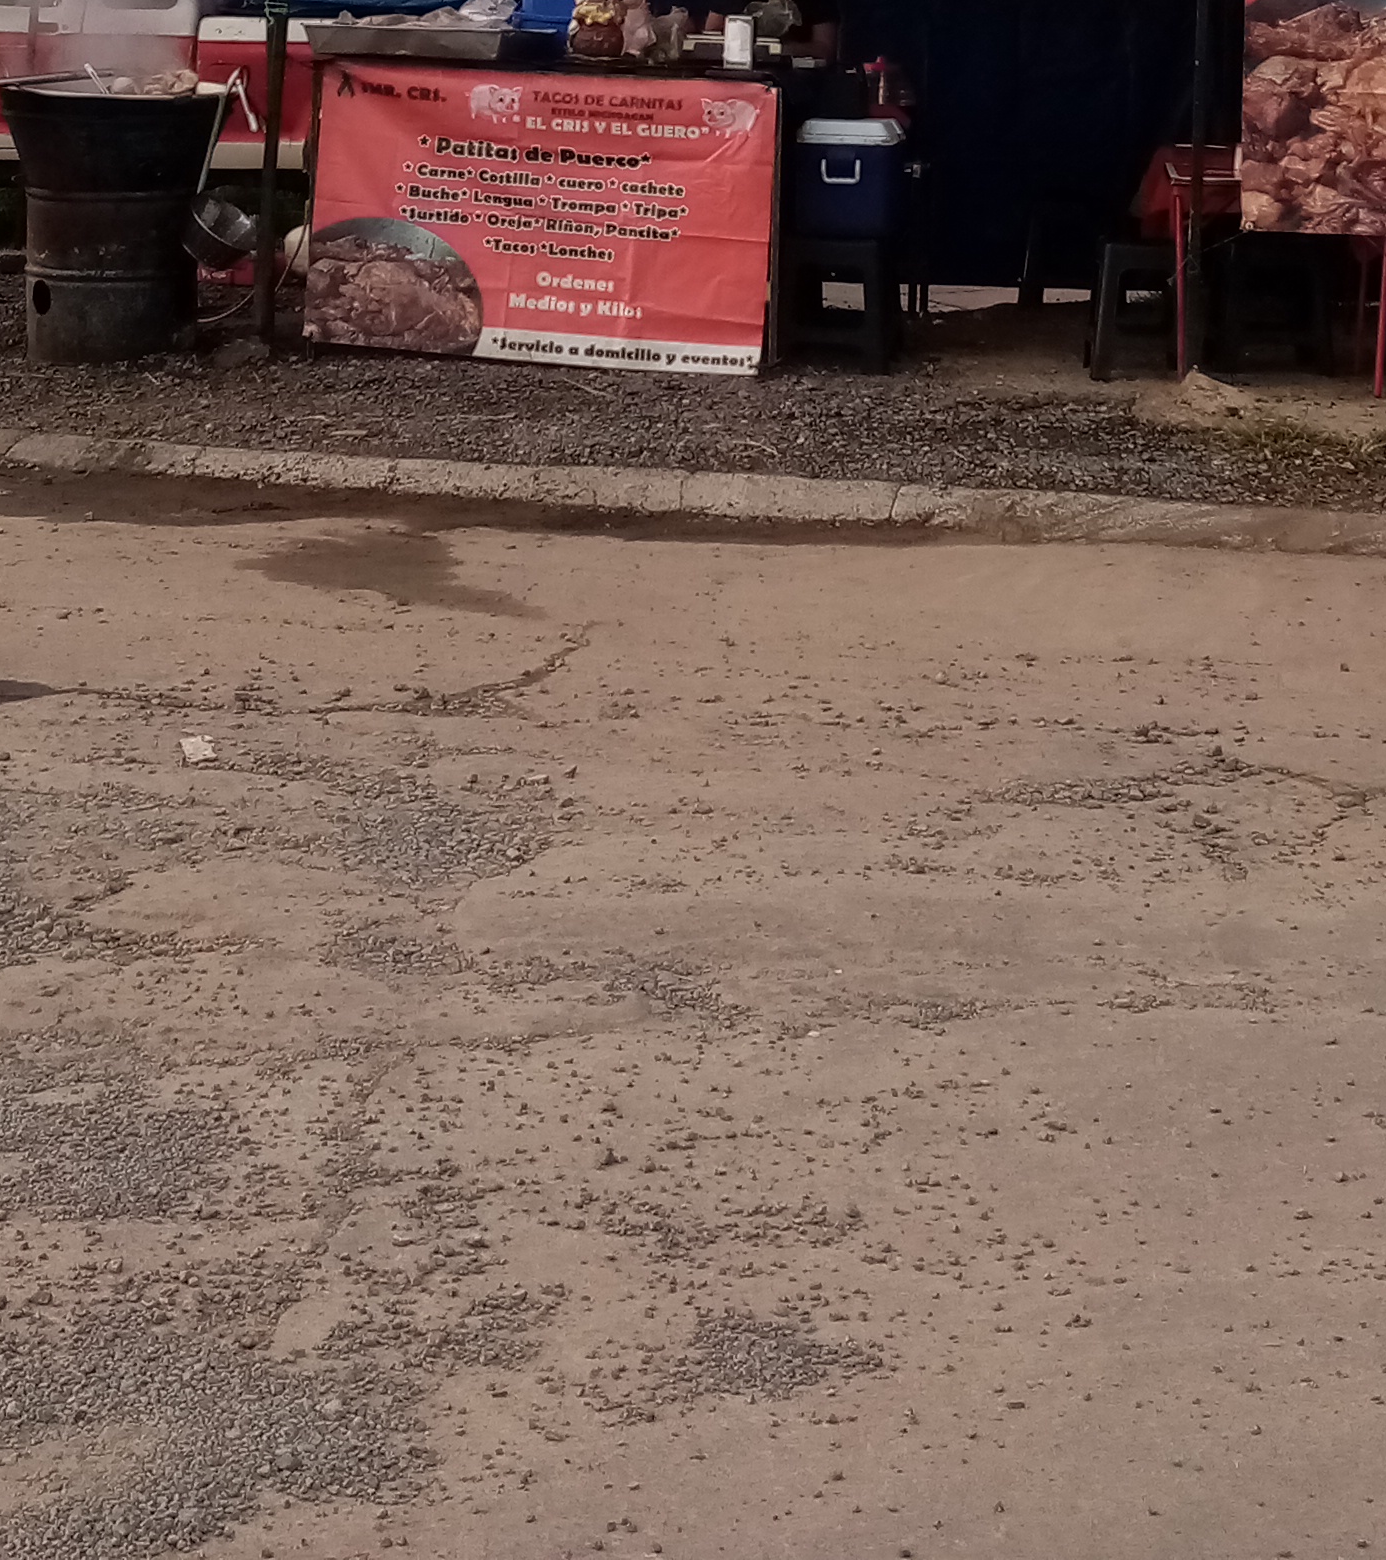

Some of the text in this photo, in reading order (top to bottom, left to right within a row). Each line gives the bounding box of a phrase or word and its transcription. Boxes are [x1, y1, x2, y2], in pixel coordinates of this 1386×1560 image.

[533, 90, 683, 111] TACOS DE CARNITAS
[525, 116, 547, 130] EL
[550, 118, 590, 133] CRIS
[594, 121, 607, 134] Y
[610, 122, 633, 136] EL
[435, 136, 520, 162] Patitas
[524, 144, 555, 165] de
[478, 168, 542, 187] Costilla
[557, 175, 605, 192] cuero
[620, 180, 686, 198] cachete
[472, 189, 534, 208] Lengua
[550, 196, 618, 216] Trompa
[536, 271, 615, 293] Ordenes
[508, 293, 643, 319] Medios y Kilos
[569, 345, 579, 356] a
[584, 343, 661, 363] domicilio
[666, 352, 677, 365] y
